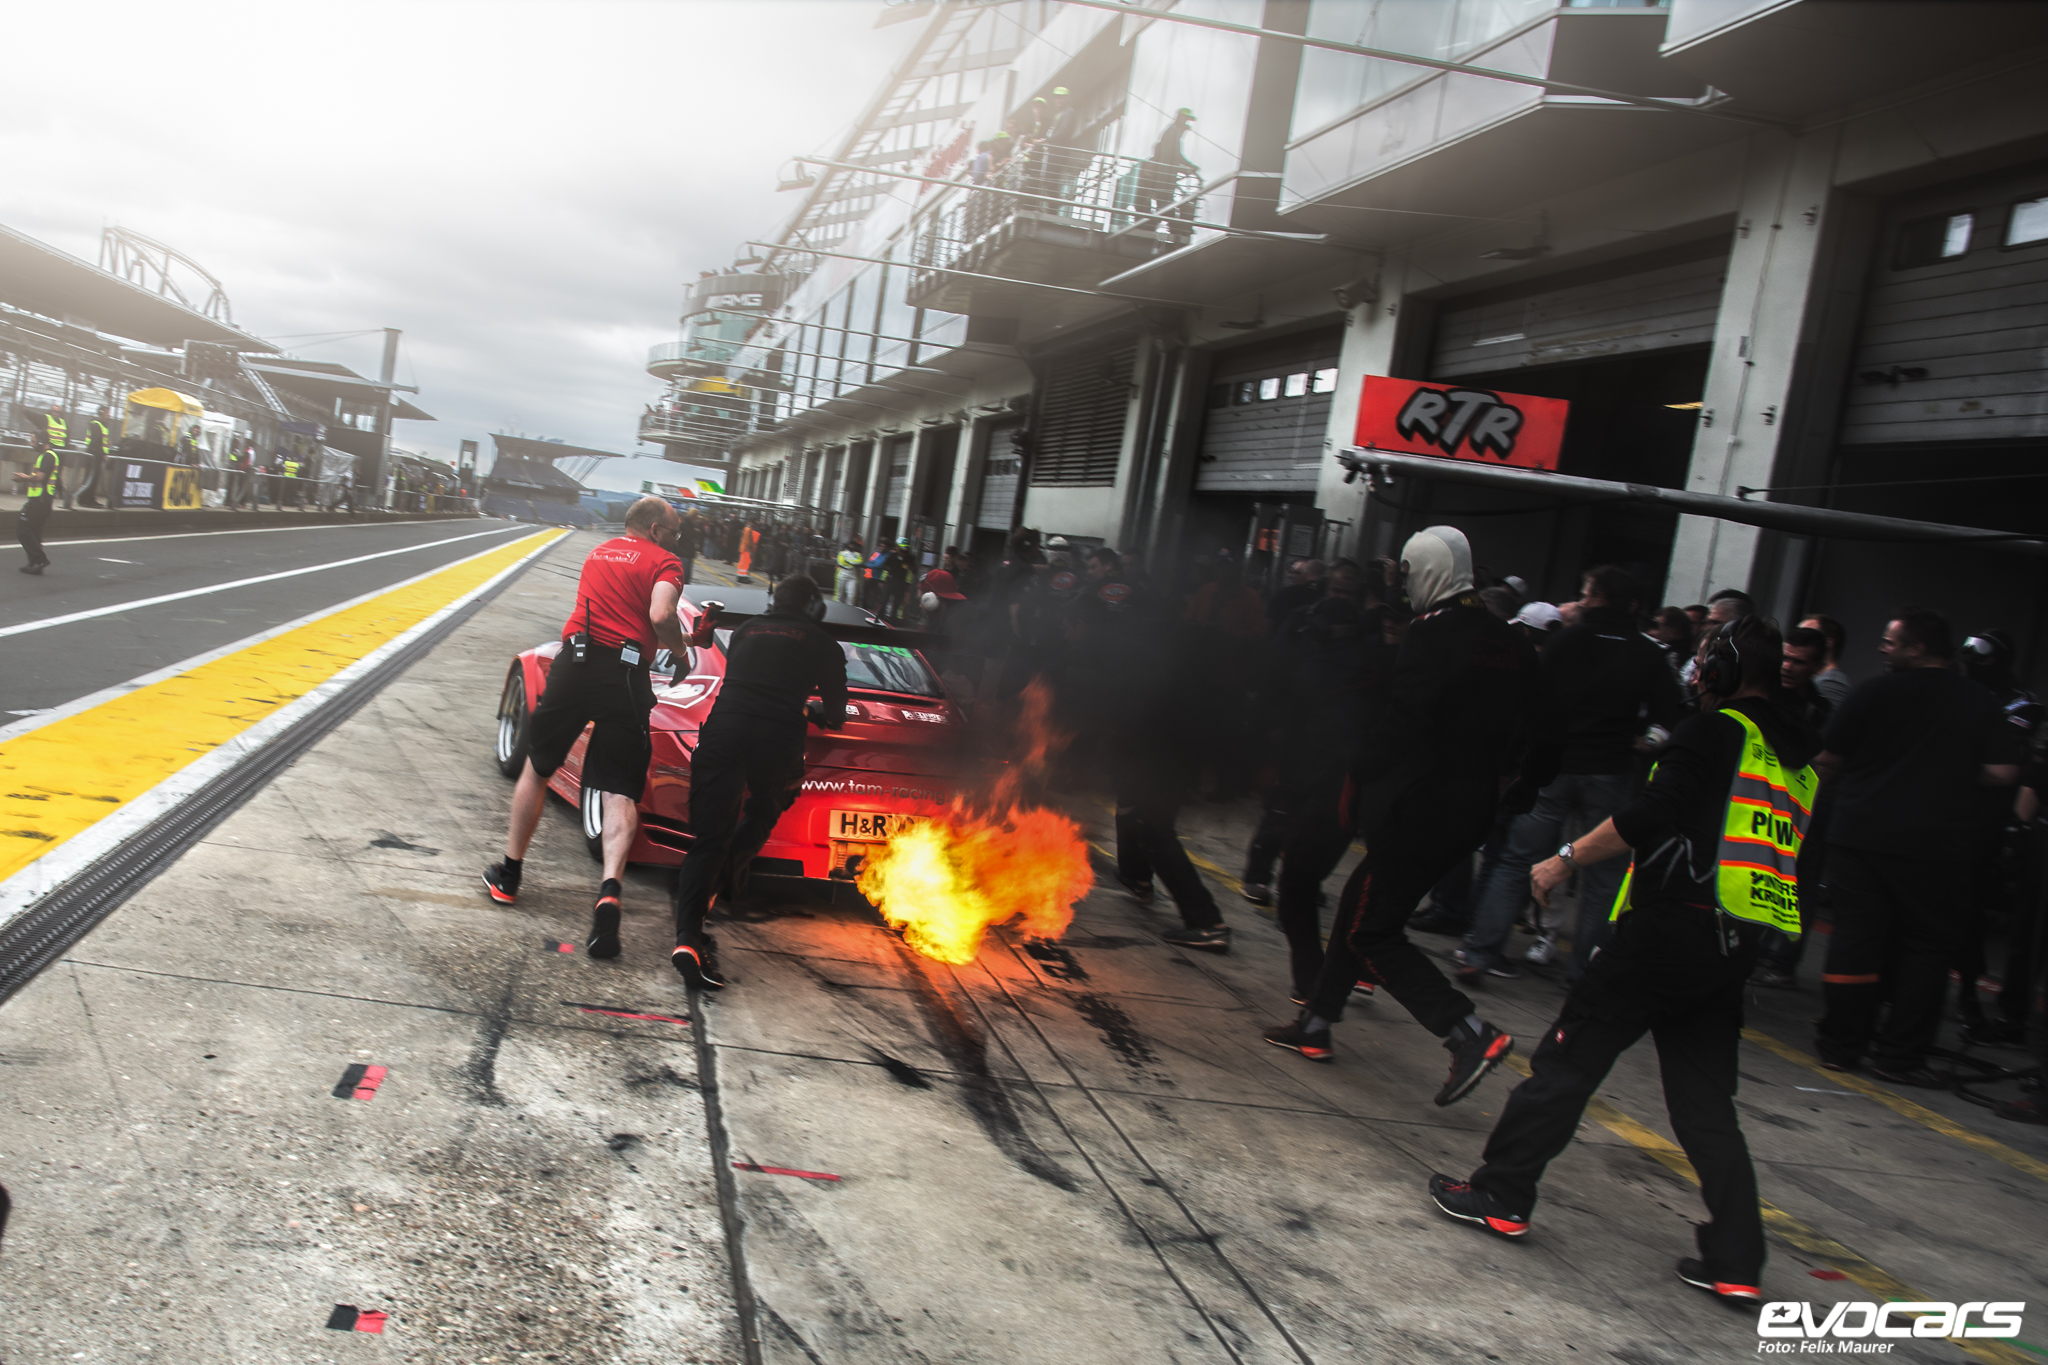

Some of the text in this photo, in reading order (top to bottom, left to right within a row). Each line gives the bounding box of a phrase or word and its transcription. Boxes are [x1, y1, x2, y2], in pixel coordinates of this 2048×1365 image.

[719, 293, 763, 307] AMG
[1397, 387, 1524, 460] RTR
[841, 812, 888, 837] H&R
